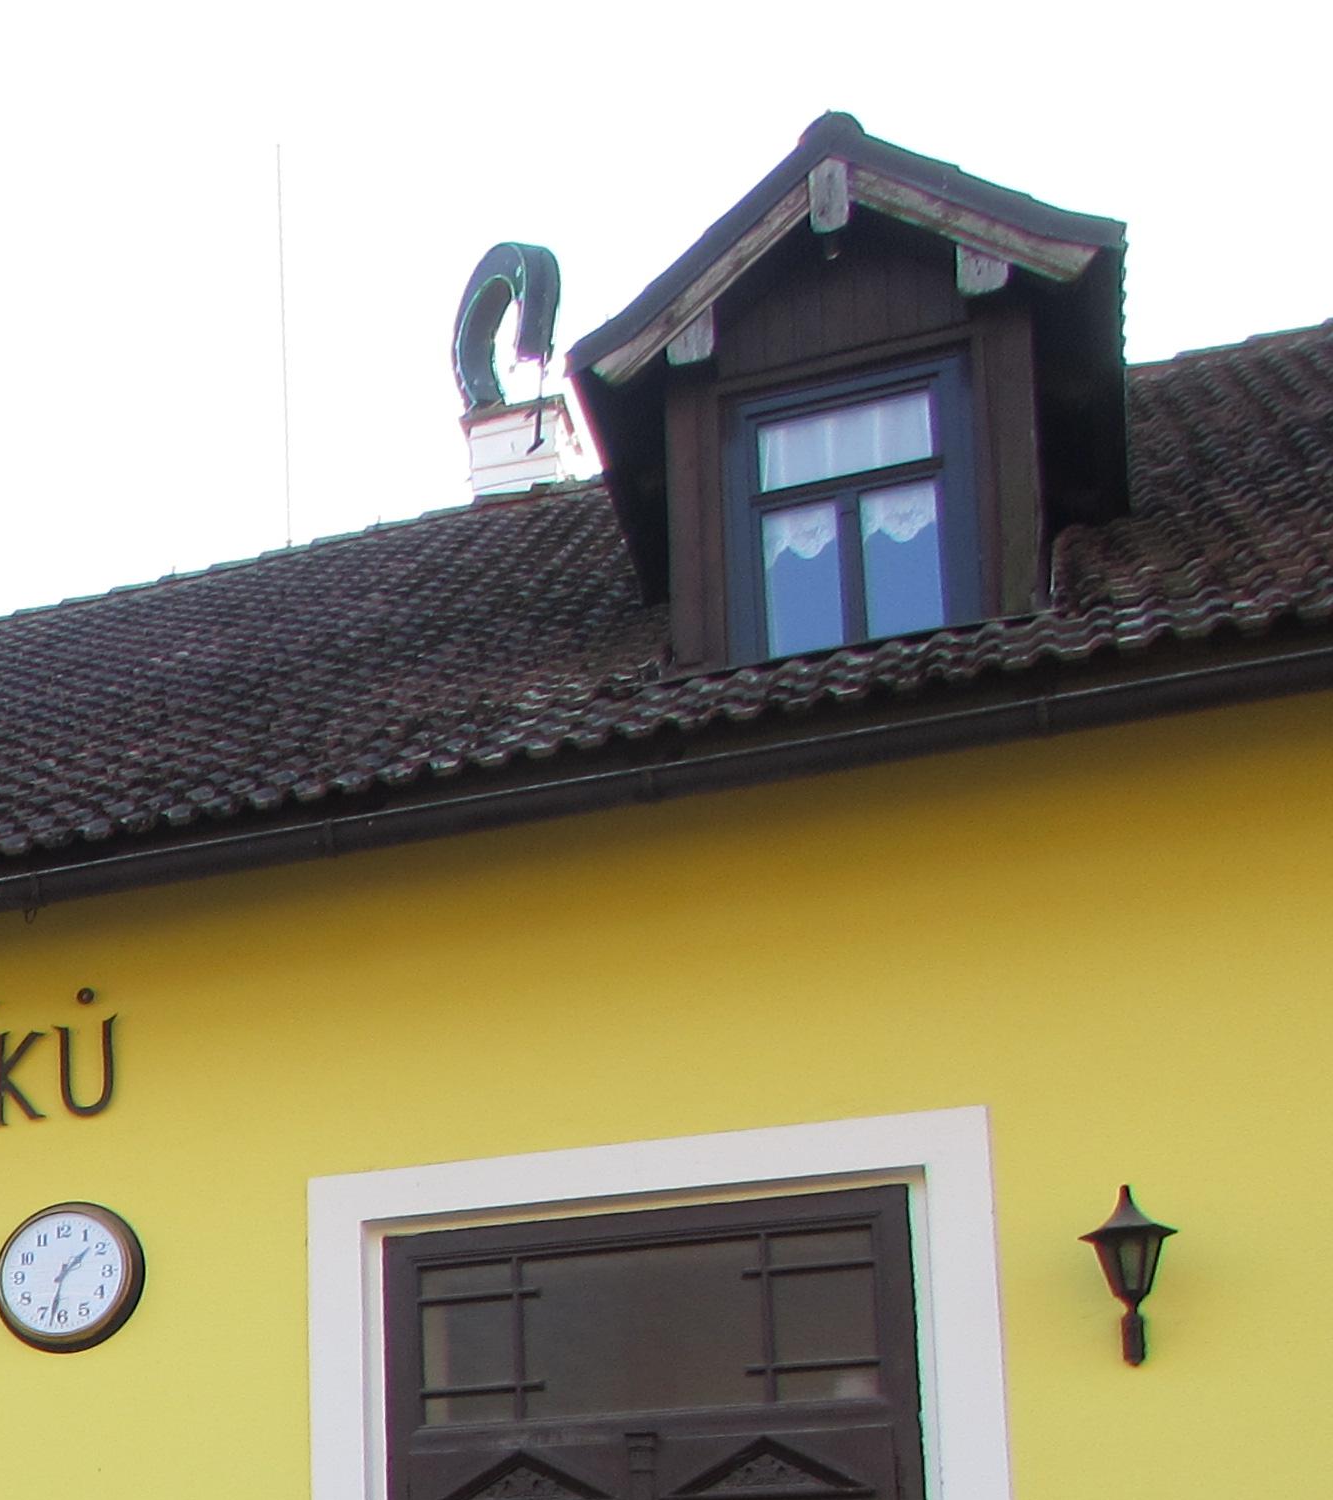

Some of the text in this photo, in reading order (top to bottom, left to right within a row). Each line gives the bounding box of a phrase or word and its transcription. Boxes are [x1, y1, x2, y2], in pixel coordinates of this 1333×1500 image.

[56, 1224, 71, 1239] 12
[81, 1228, 89, 1242] 1
[36, 1233, 48, 1247] 11
[94, 1242, 107, 1255] 2
[20, 1251, 34, 1265] 10
[13, 1271, 25, 1285] 9
[101, 1264, 113, 1278] 3
[19, 1291, 32, 1305] 8
[93, 1284, 105, 1299] 4
[37, 1306, 49, 1320] 7
[56, 1309, 68, 1324] 6
[78, 1302, 90, 1317] 5
